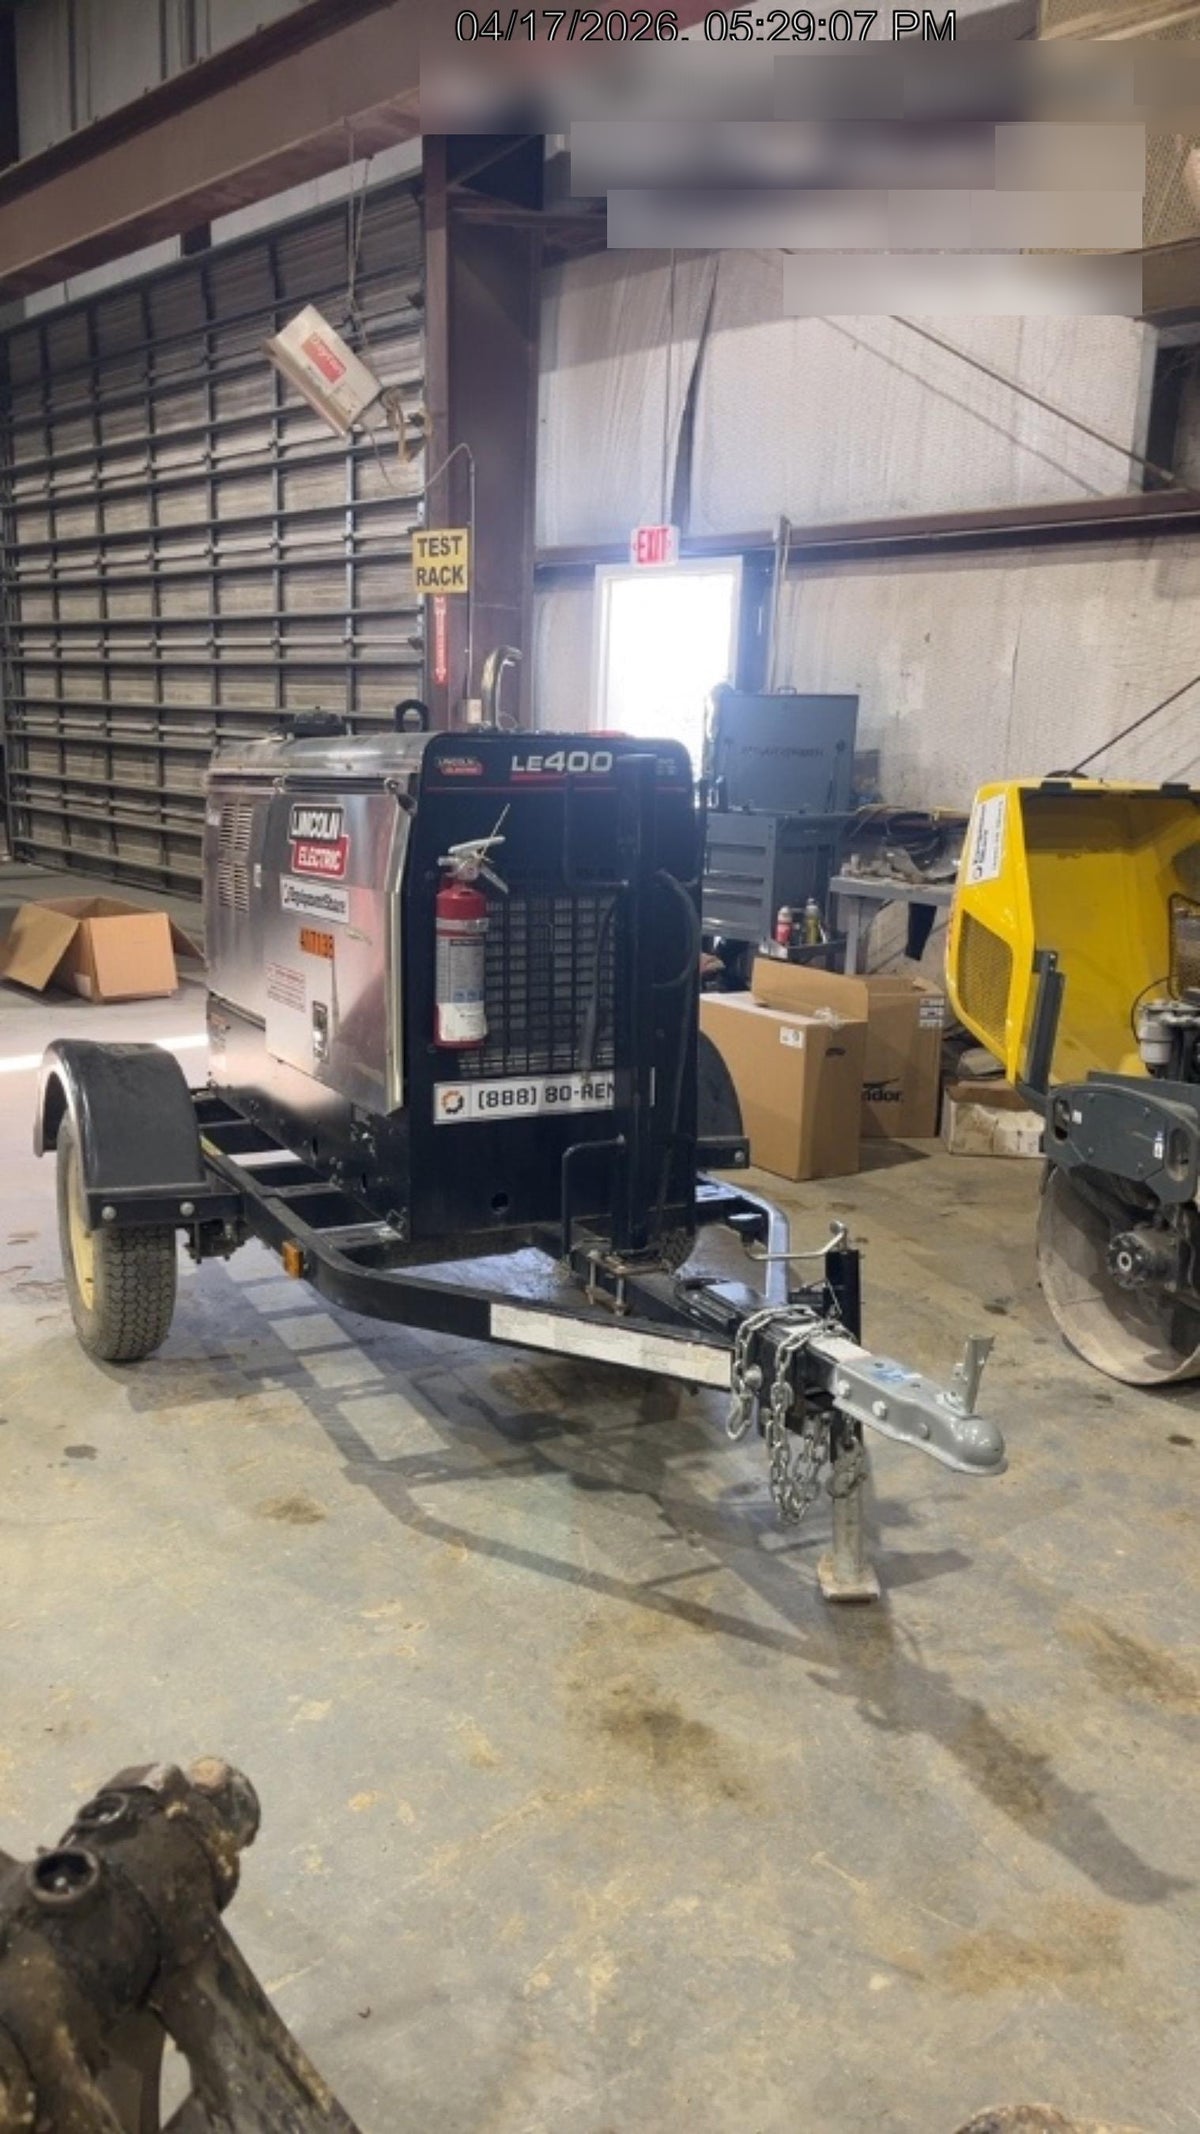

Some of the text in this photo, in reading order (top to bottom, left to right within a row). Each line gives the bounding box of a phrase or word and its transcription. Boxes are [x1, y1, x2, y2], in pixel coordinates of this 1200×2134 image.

[417, 535, 463, 557] TEST
[637, 528, 668, 564] EXIT
[416, 567, 464, 587] RACK
[511, 751, 613, 772] LE400
[291, 810, 341, 840] LINCOLN
[298, 846, 342, 871] ELECTRIC
